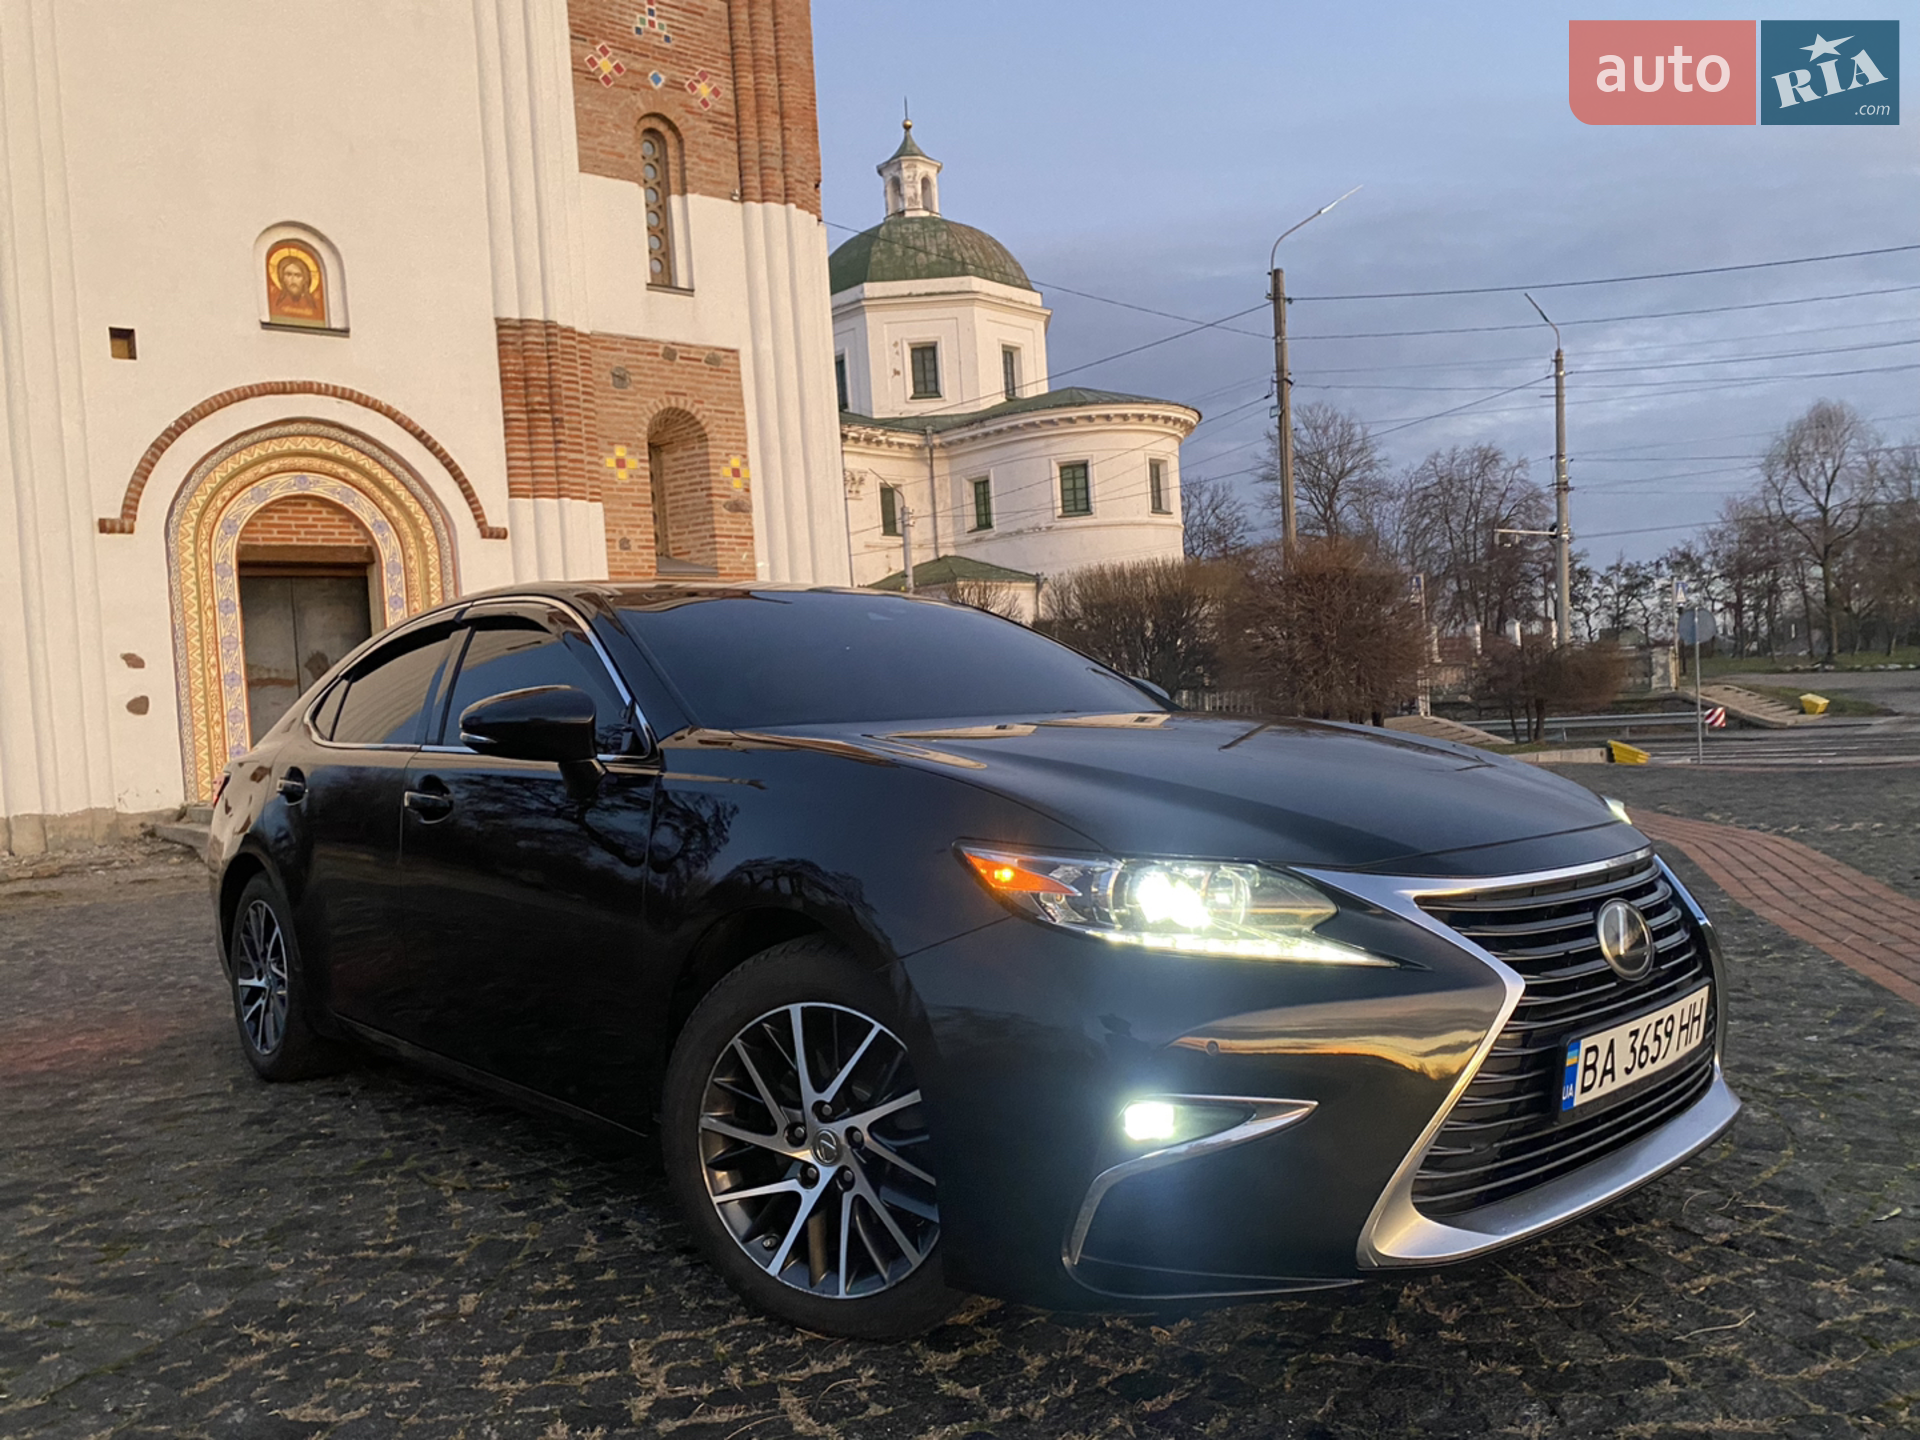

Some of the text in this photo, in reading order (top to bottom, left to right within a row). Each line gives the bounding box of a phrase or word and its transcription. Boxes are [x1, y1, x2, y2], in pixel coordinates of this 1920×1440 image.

[1580, 997, 1704, 1095] BA 3659 HH
[1562, 1084, 1573, 1100] UA
